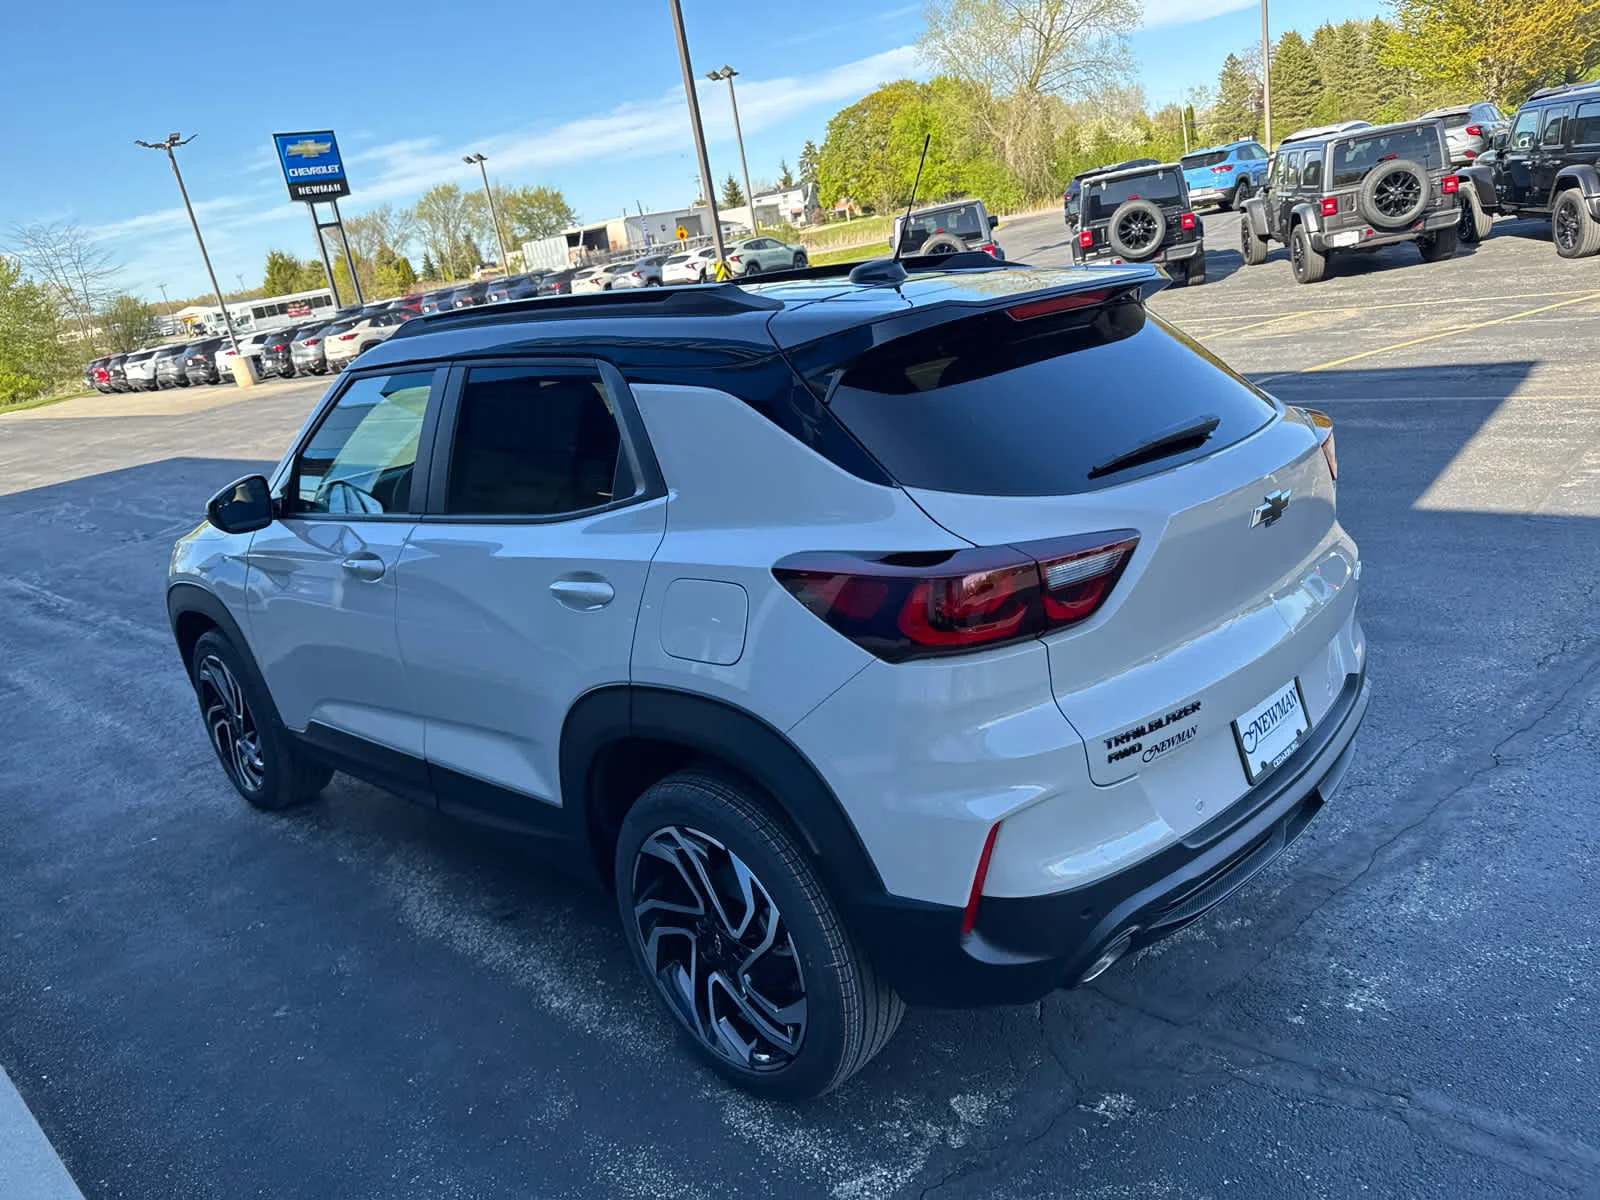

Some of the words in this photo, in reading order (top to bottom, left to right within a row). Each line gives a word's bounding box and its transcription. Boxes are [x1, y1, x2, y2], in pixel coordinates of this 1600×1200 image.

[288, 164, 340, 177] CHEVROLET
[298, 183, 341, 196] NEWMAN
[1104, 700, 1201, 750] TRAILBLAZER
[1242, 688, 1298, 754] NEWMAN
[1107, 742, 1143, 764] AWD
[1142, 726, 1198, 763] NEWMAN
